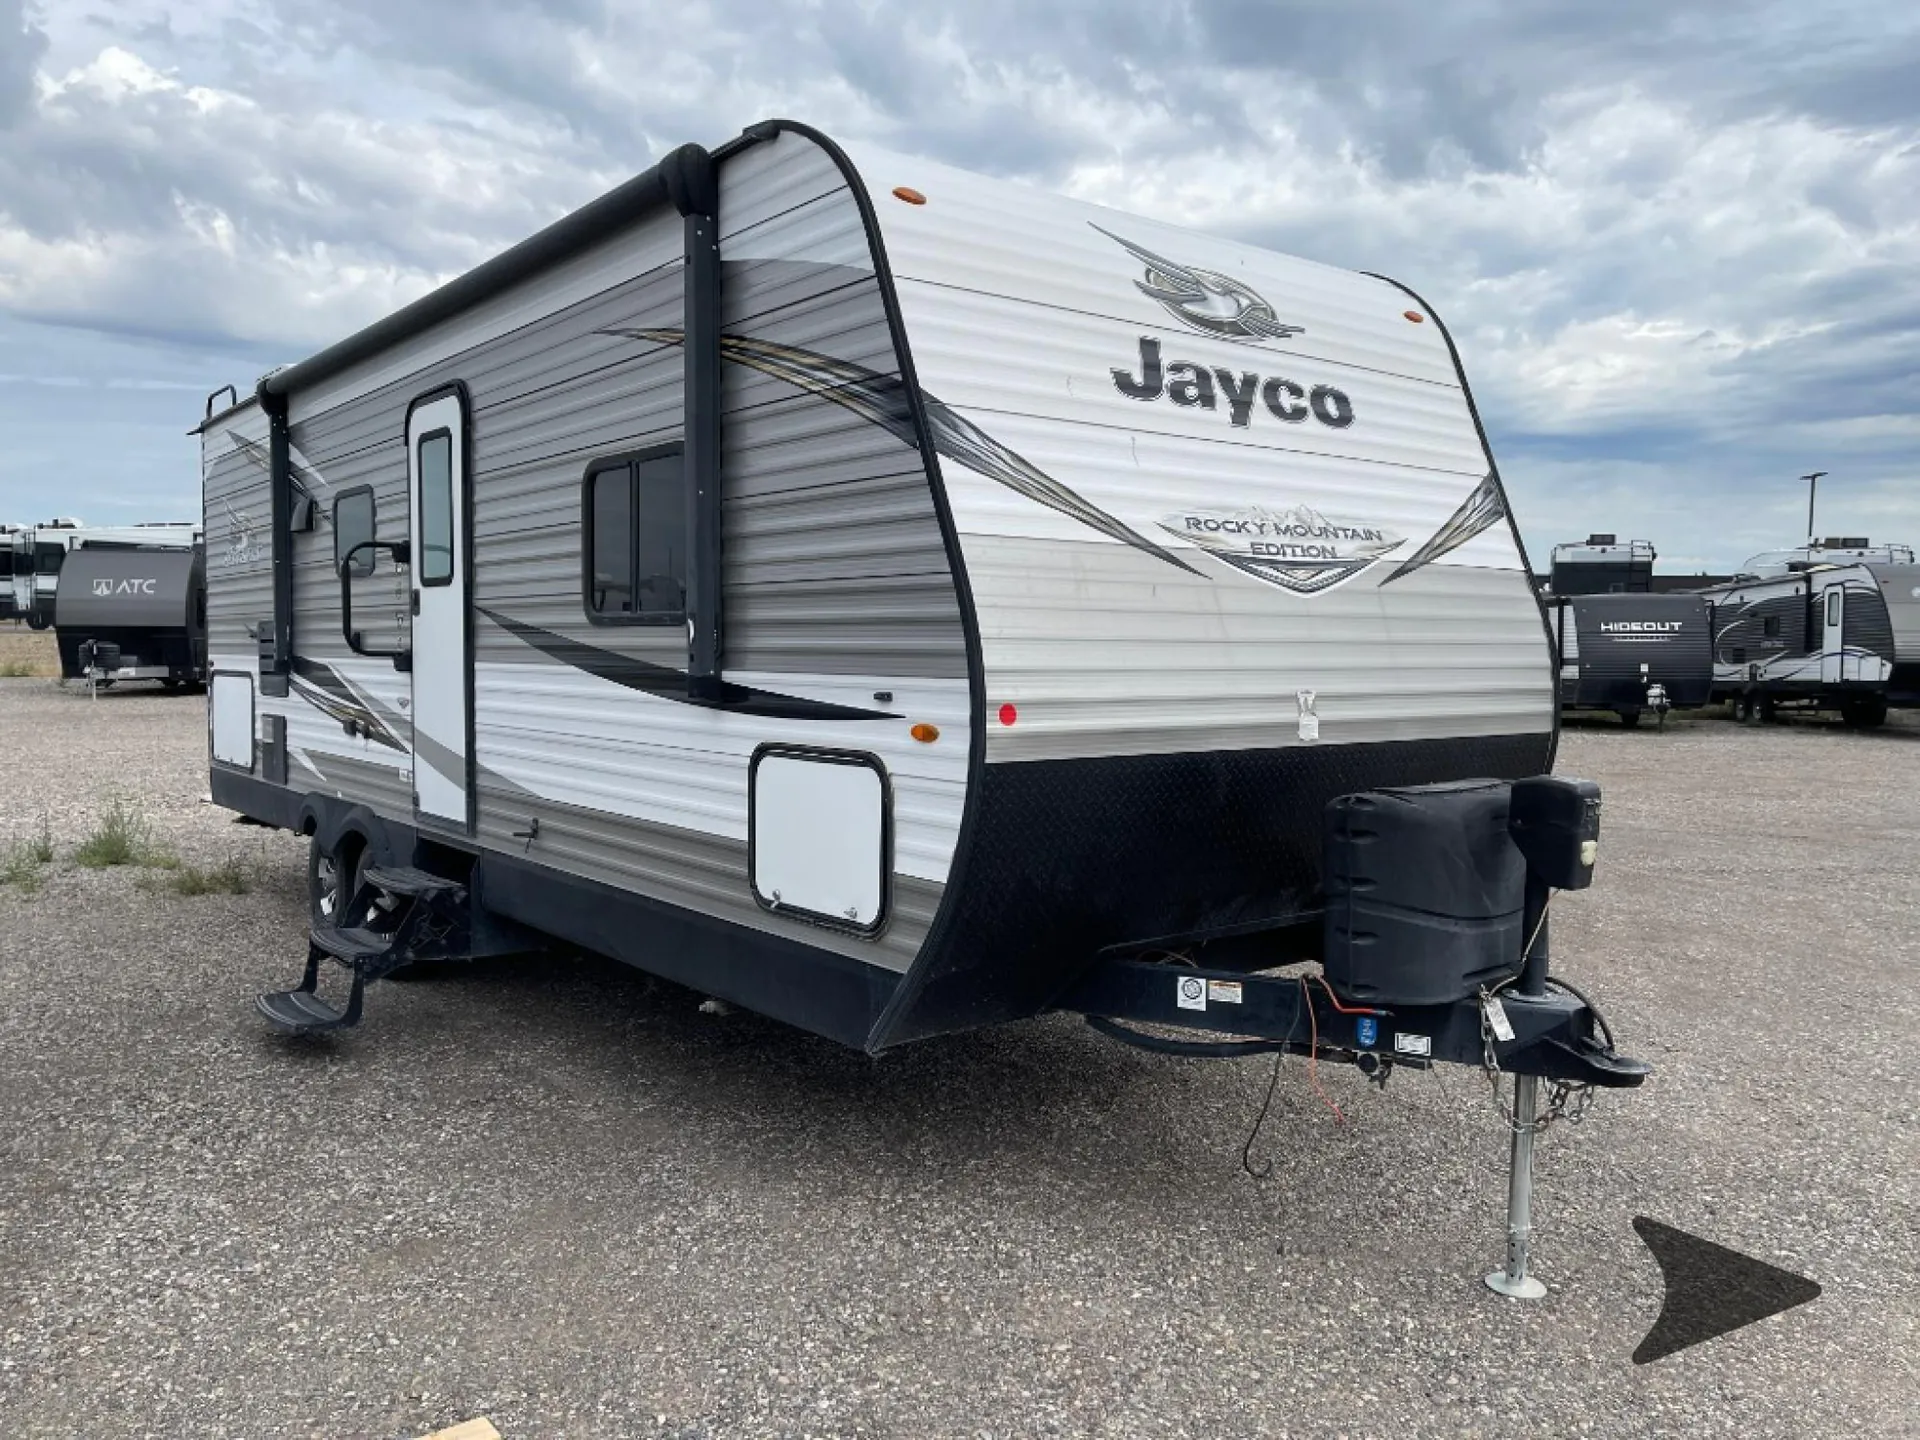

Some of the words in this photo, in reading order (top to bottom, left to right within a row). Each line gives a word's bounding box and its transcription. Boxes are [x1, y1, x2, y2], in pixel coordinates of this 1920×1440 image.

[1110, 335, 1356, 429] Jayco
[1184, 516, 1267, 535] ROCKY
[1273, 522, 1383, 541] MOUNTAIN
[1250, 541, 1337, 559] EDITION
[115, 578, 157, 594] ATC
[1600, 621, 1683, 631] HIDEOUT
